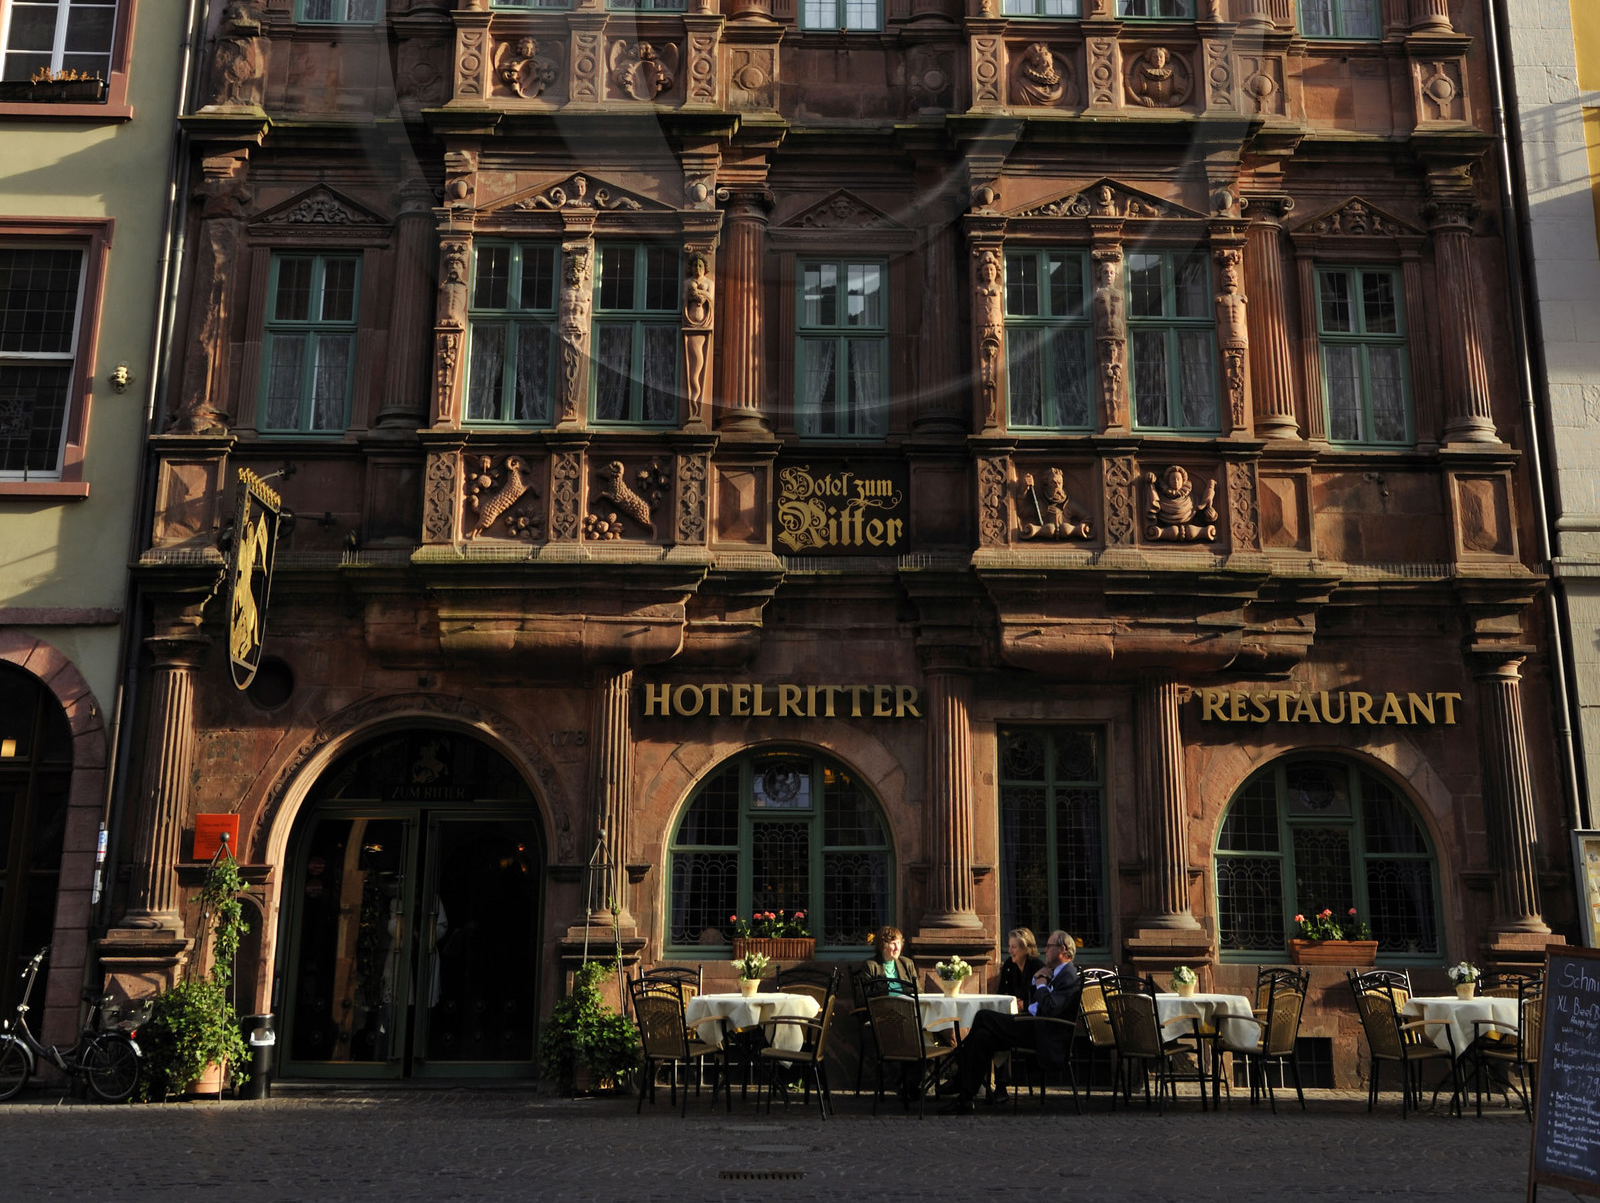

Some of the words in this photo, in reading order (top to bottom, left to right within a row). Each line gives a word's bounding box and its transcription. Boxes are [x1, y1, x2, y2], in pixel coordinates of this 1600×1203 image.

[780, 464, 853, 500] Hotel
[851, 479, 898, 507] zum
[777, 497, 904, 553] Ritter
[644, 683, 772, 717] HOTEL
[778, 684, 923, 718] RITTER
[1200, 689, 1462, 725] RESTAURANT
[391, 786, 421, 799] ZUM
[424, 786, 465, 799] RITTER
[1557, 995, 1568, 1013] XL
